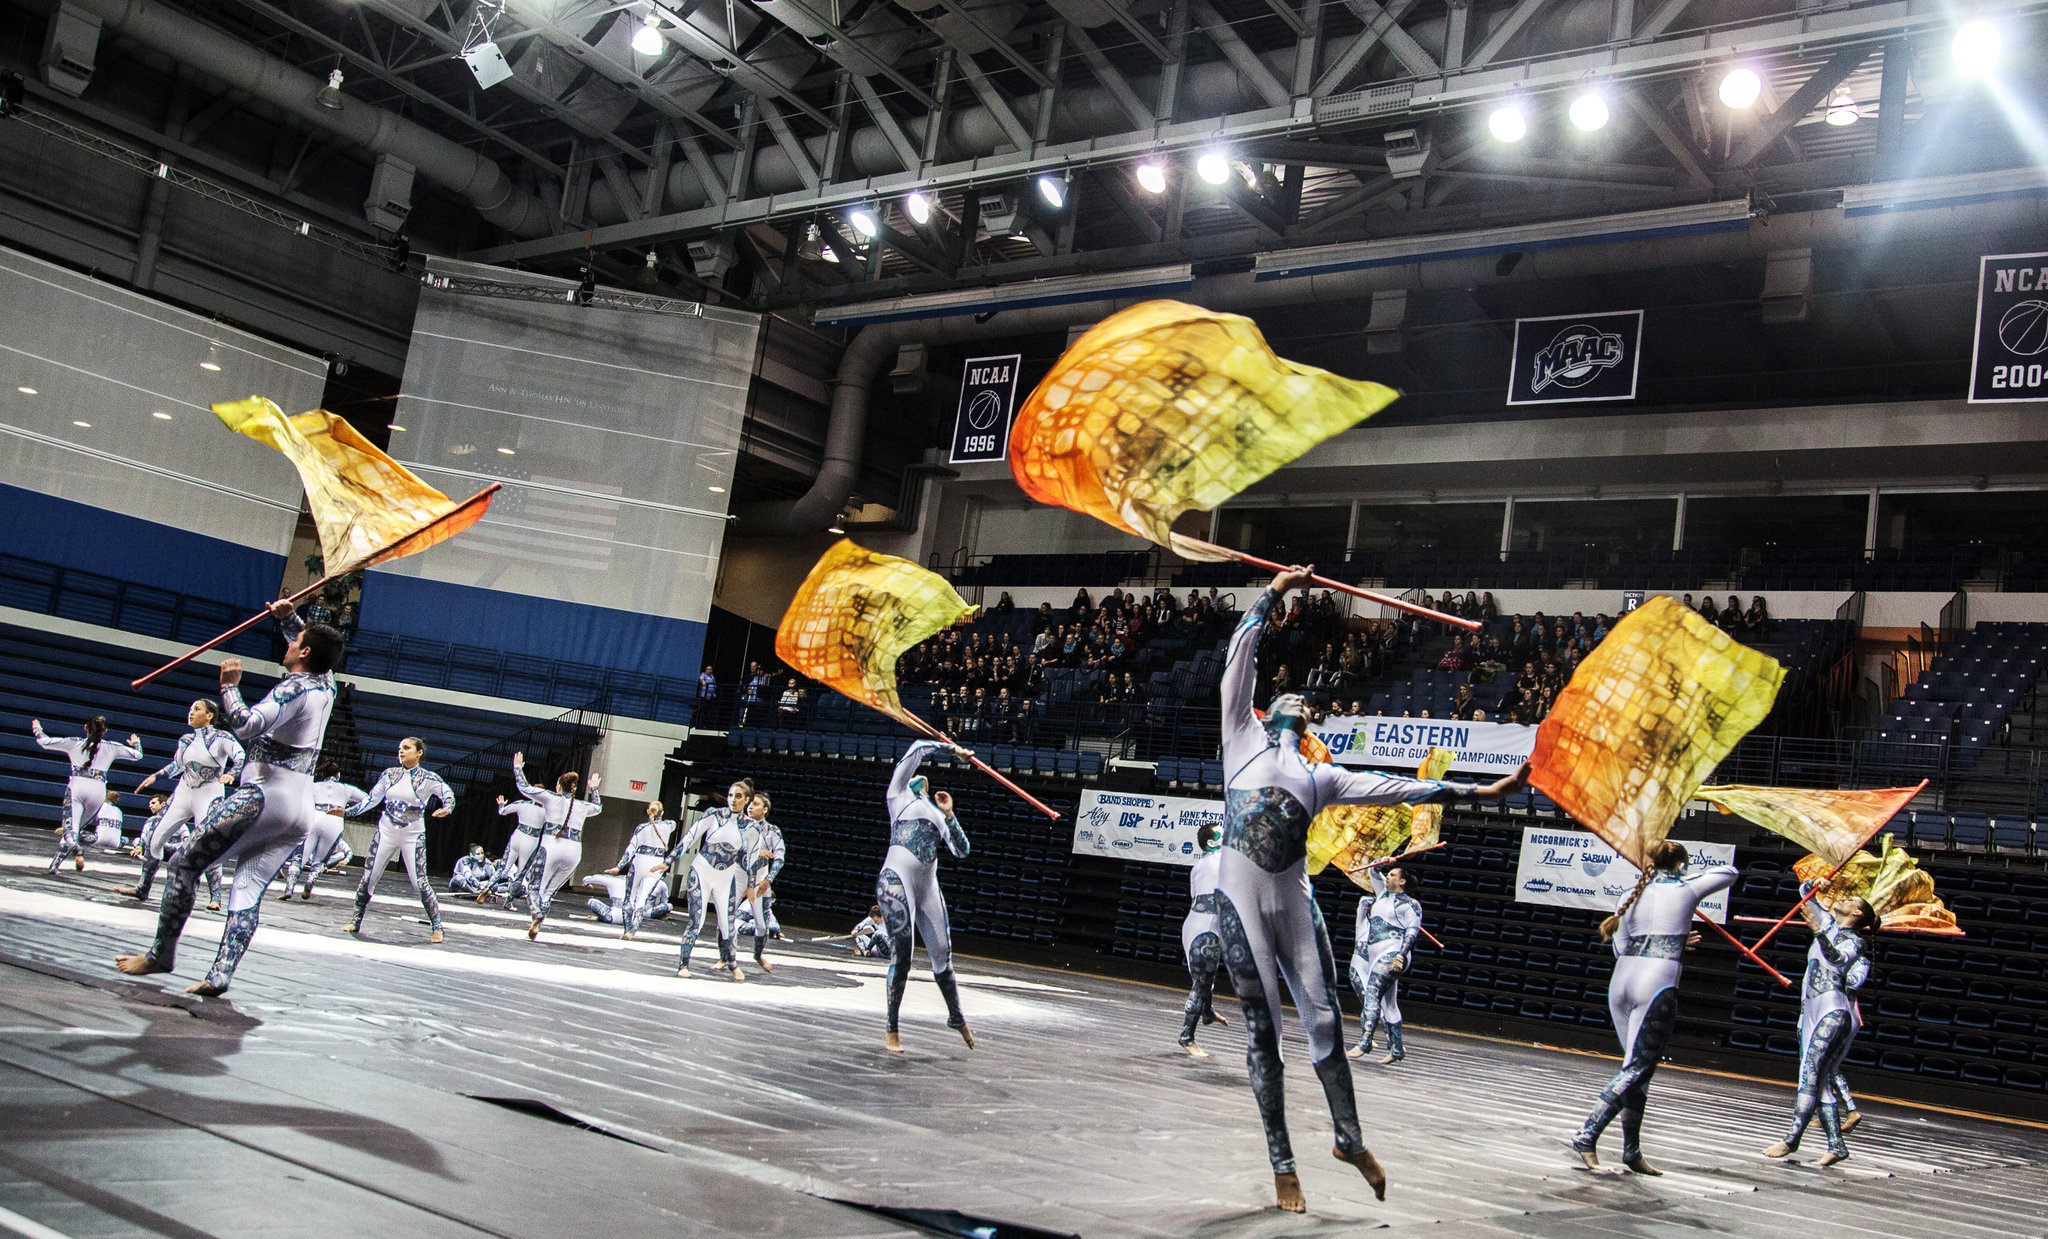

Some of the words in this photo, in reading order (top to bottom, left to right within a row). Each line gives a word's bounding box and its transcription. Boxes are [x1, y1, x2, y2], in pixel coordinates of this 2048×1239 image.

[1531, 333, 1624, 394] MAAC
[969, 366, 1010, 385] NCAA
[555, 394, 572, 404] HN
[963, 435, 995, 453] 1996
[1628, 598, 1638, 611] R
[1374, 723, 1469, 748] EASTERN
[1372, 745, 1405, 758] COLOR
[1408, 748, 1429, 759] GUA
[1453, 751, 1528, 766] HAMPIONSHIP
[1099, 794, 1121, 805] BAND
[1122, 797, 1151, 808] SHOPPE
[1179, 810, 1201, 819] LONE
[1208, 812, 1225, 821] STA
[1178, 818, 1225, 828] PERCUSSIO
[1530, 834, 1589, 848] MCCORMICK'S
[1537, 848, 1575, 865] Pearl
[1580, 853, 1612, 864] SABIAN
[1687, 848, 1726, 870] Zildjian
[1556, 886, 1596, 896] PROMARK
[1698, 901, 1722, 910] AMAHA
